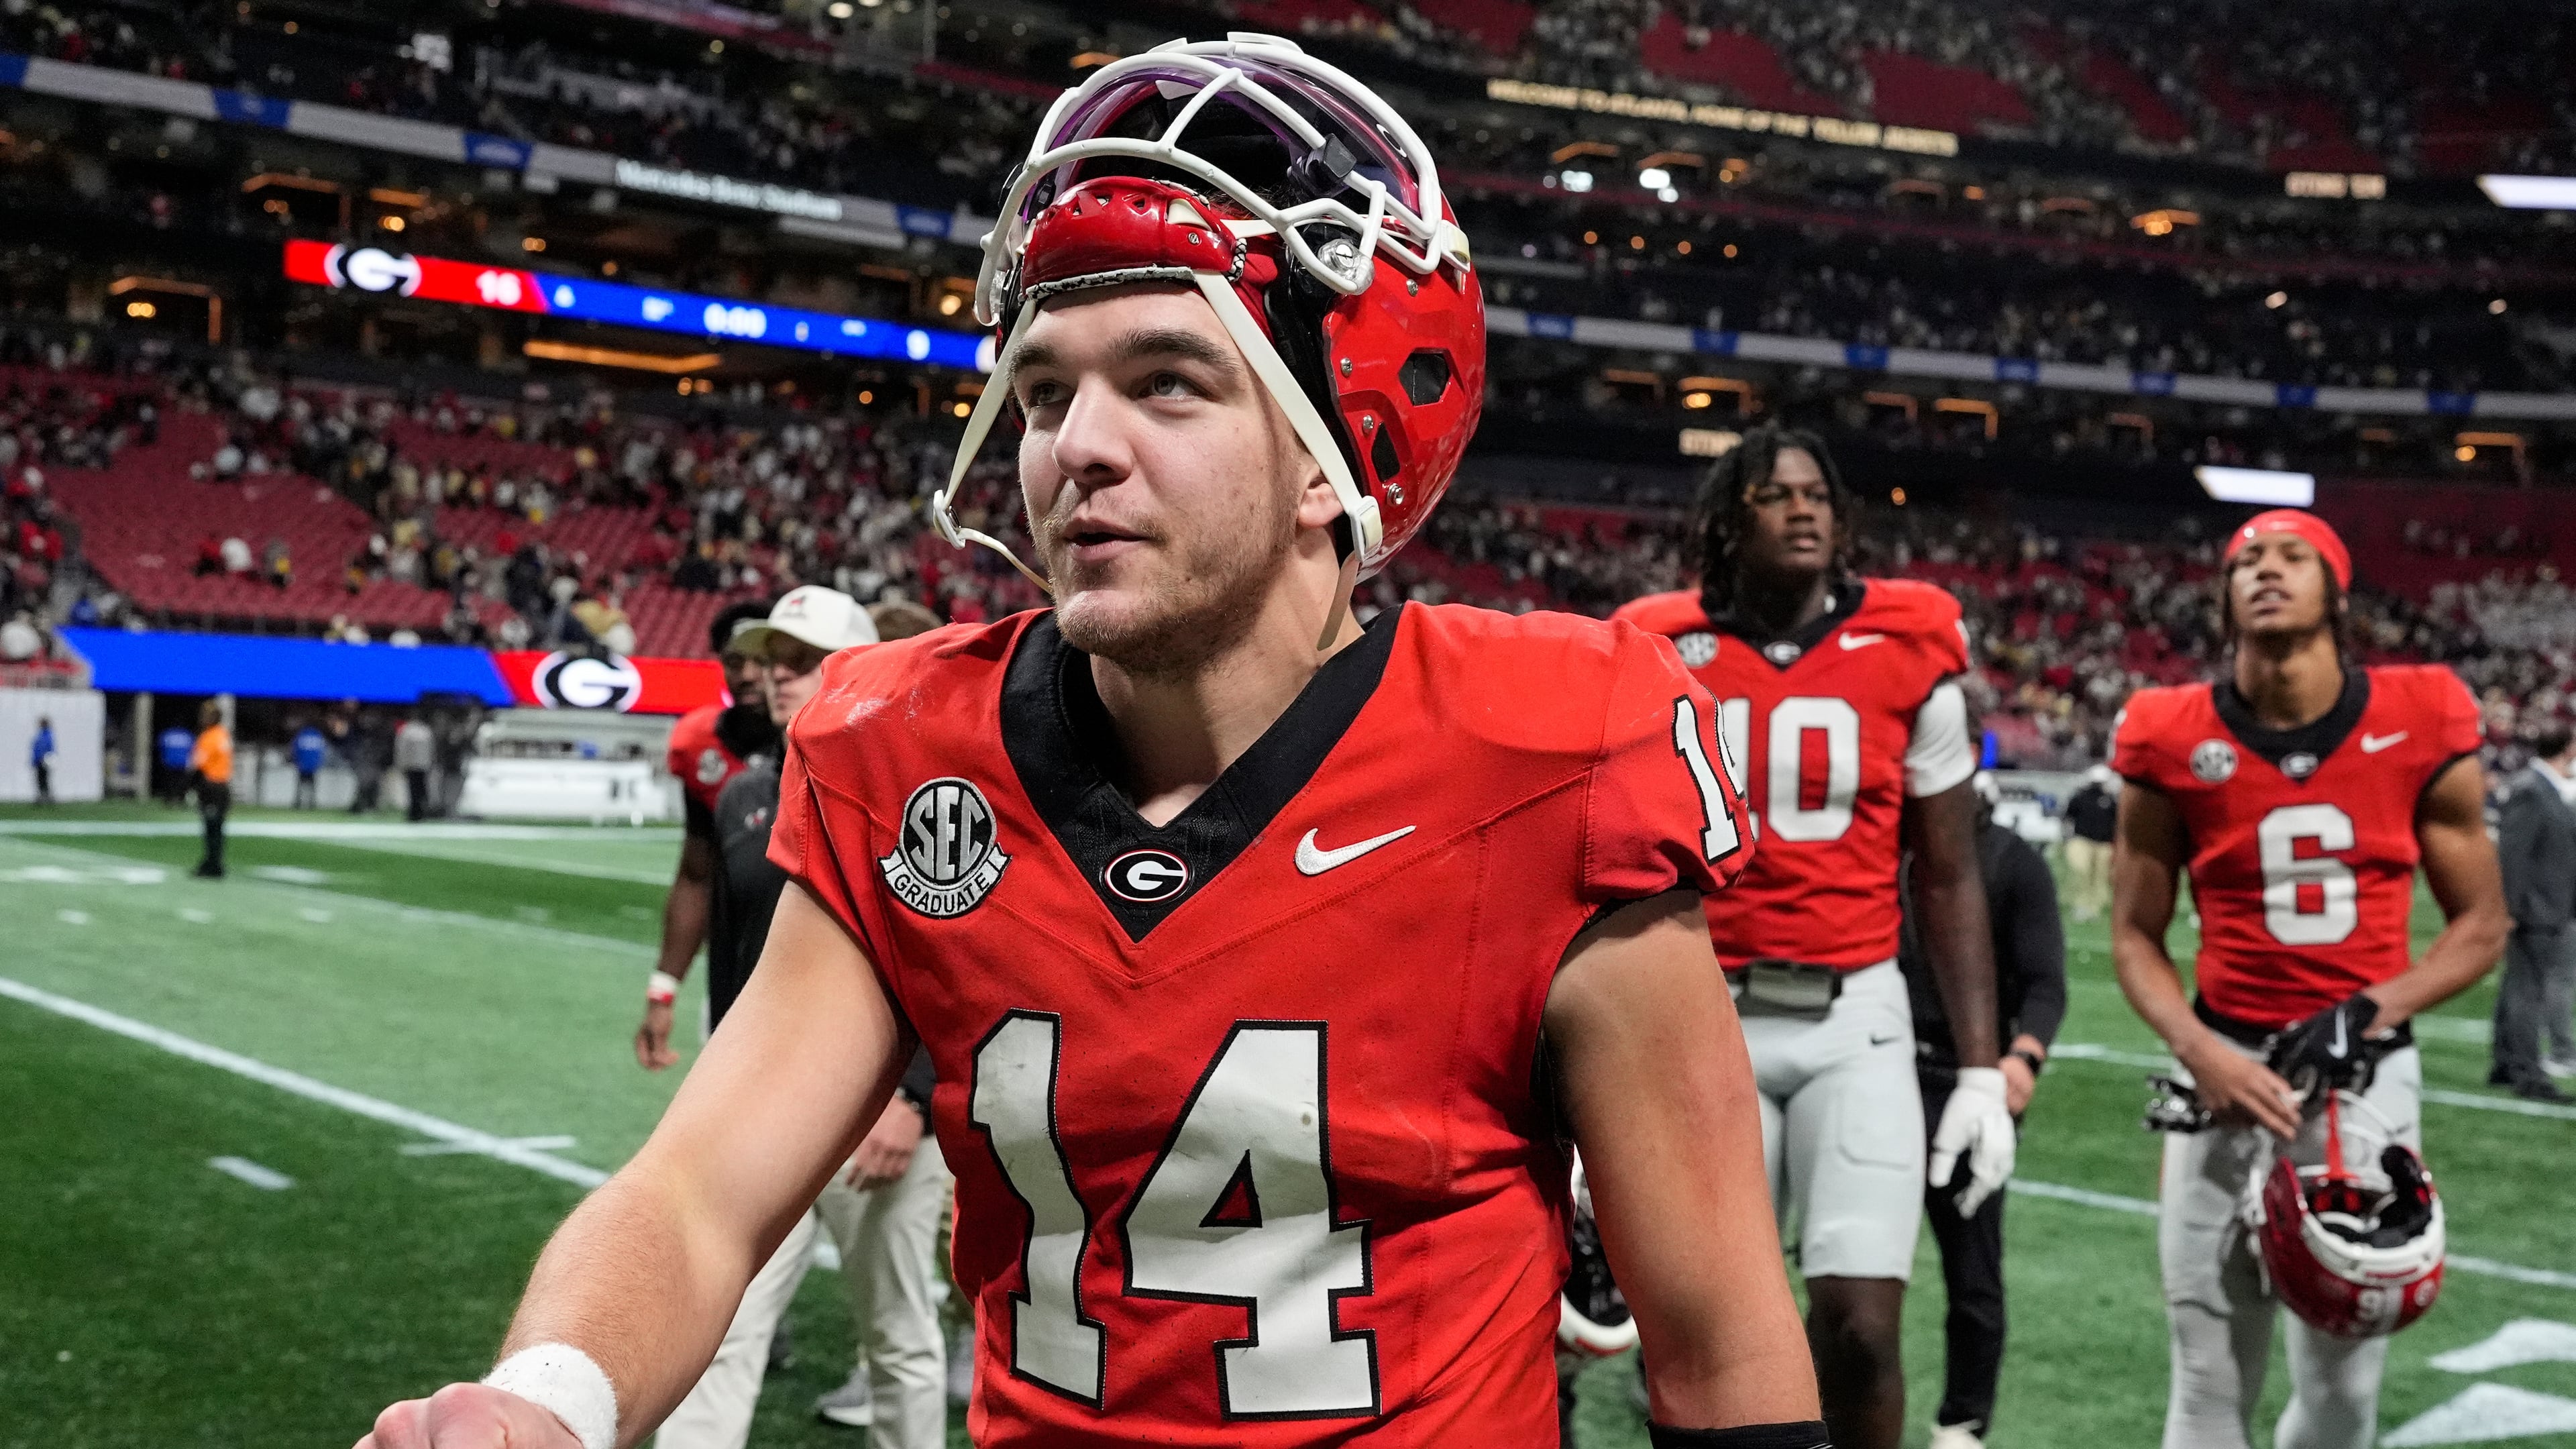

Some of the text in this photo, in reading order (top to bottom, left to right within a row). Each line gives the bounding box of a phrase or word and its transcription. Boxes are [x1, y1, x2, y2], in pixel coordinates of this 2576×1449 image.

[476, 270, 521, 306] 16
[909, 786, 985, 880] SEC
[2258, 803, 2358, 946] 6
[894, 873, 990, 914] GRADUATE
[967, 1008, 1381, 1421] 14
